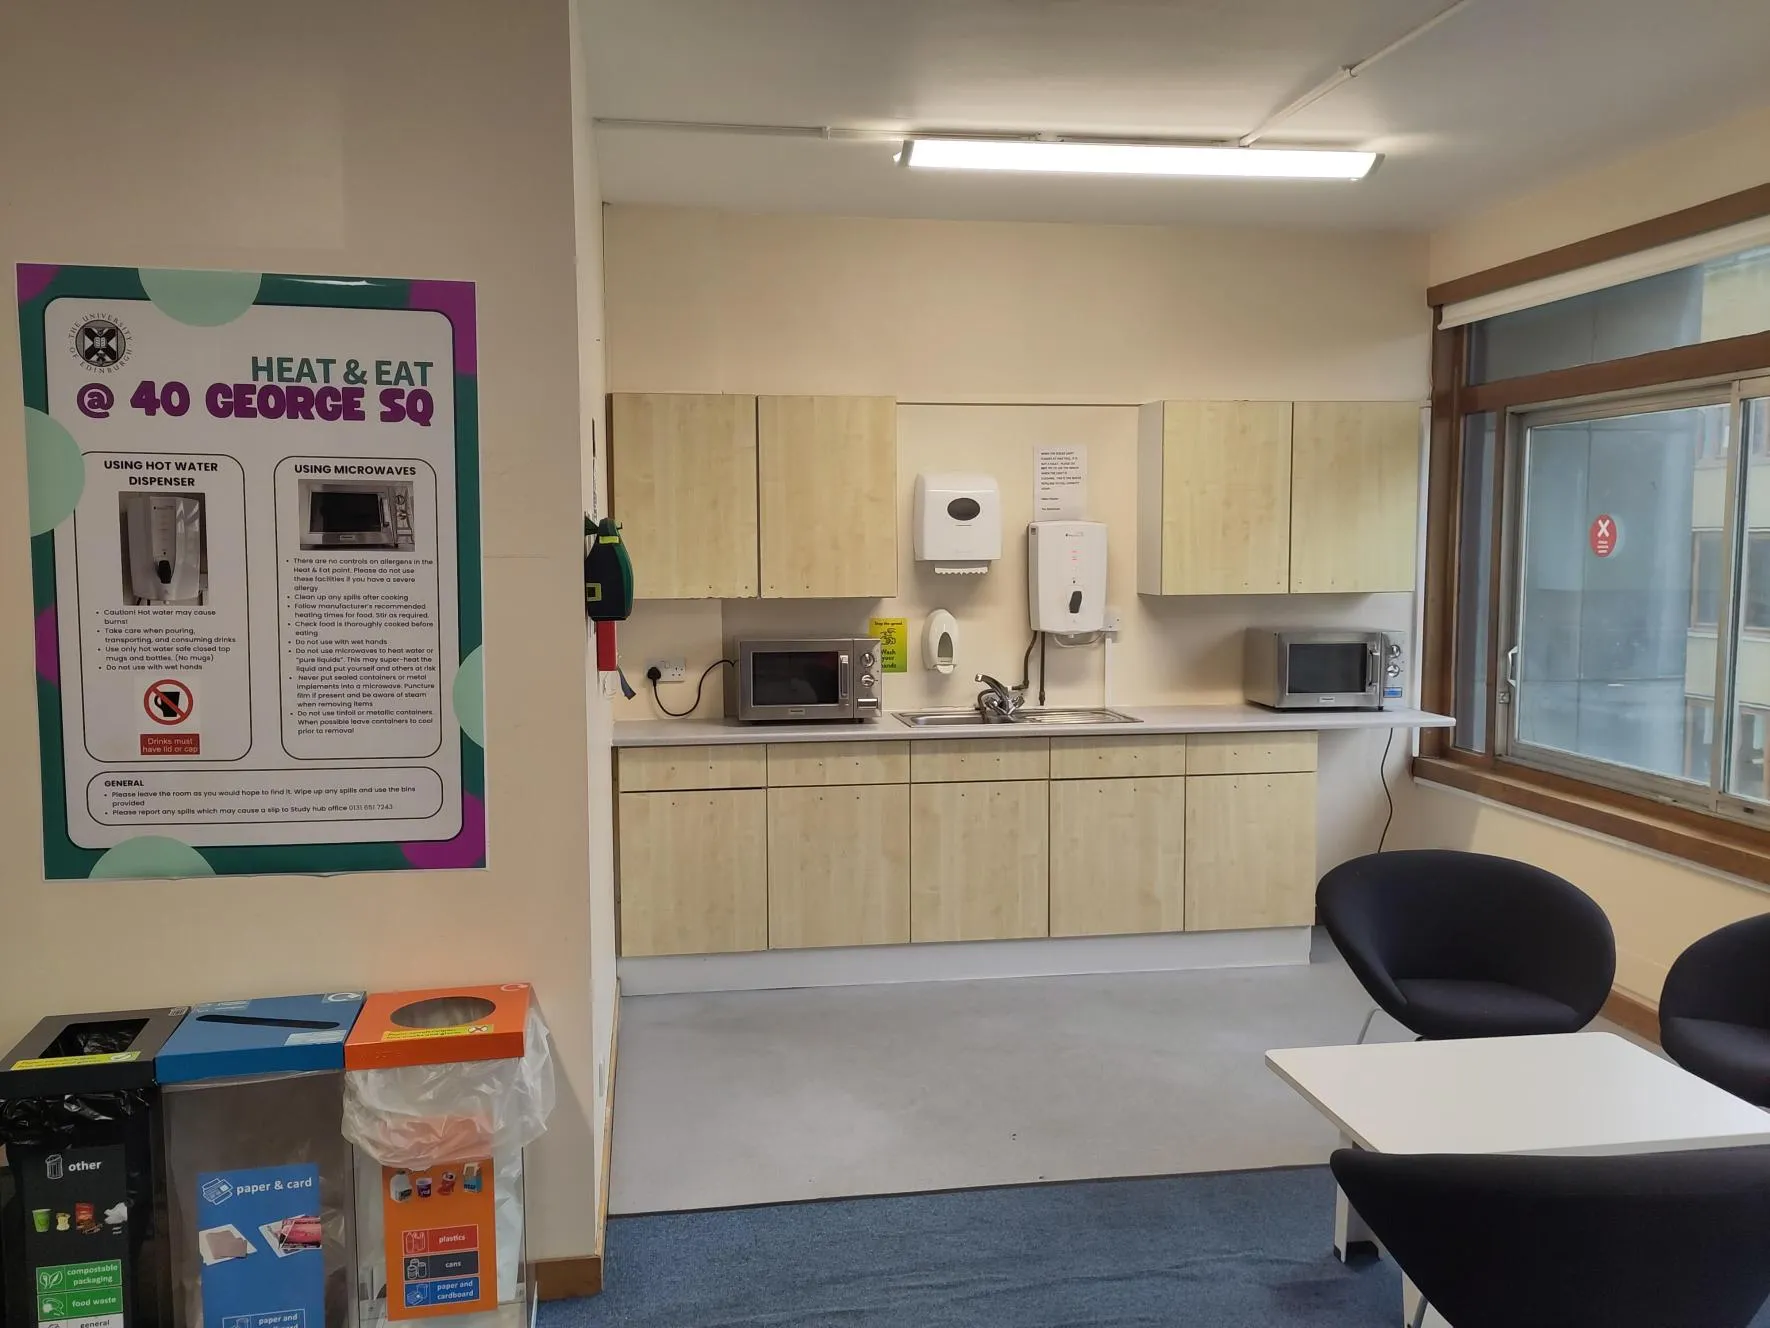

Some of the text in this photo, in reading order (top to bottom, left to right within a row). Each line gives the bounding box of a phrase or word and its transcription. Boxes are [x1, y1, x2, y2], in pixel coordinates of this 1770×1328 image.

[68, 322, 81, 339] THE
[69, 347, 133, 374] OF EDINBURGH
[251, 356, 433, 386] HEAT & EAT
[77, 381, 434, 426] @ 40 GEORGE SQ
[104, 460, 218, 472] USING HOT WATER
[294, 464, 416, 476] USING MICROWAVES
[129, 476, 195, 487] DISPENSER
[242, 789, 260, 797] hope
[294, 788, 311, 796] Wipe
[340, 787, 357, 795] spills
[177, 808, 195, 816] spills
[290, 806, 310, 814] Study
[68, 1160, 102, 1171] other
[236, 1177, 312, 1196] paper & card
[439, 1234, 466, 1244] plastics
[67, 1264, 118, 1276] compostable
[73, 1275, 113, 1286] packaging
[437, 1282, 458, 1291] paper
[437, 1290, 474, 1300] cardboard
[72, 1297, 117, 1307] food waste
[80, 1319, 110, 1328] general
[258, 1317, 281, 1326] paper
[283, 1313, 298, 1321] and
